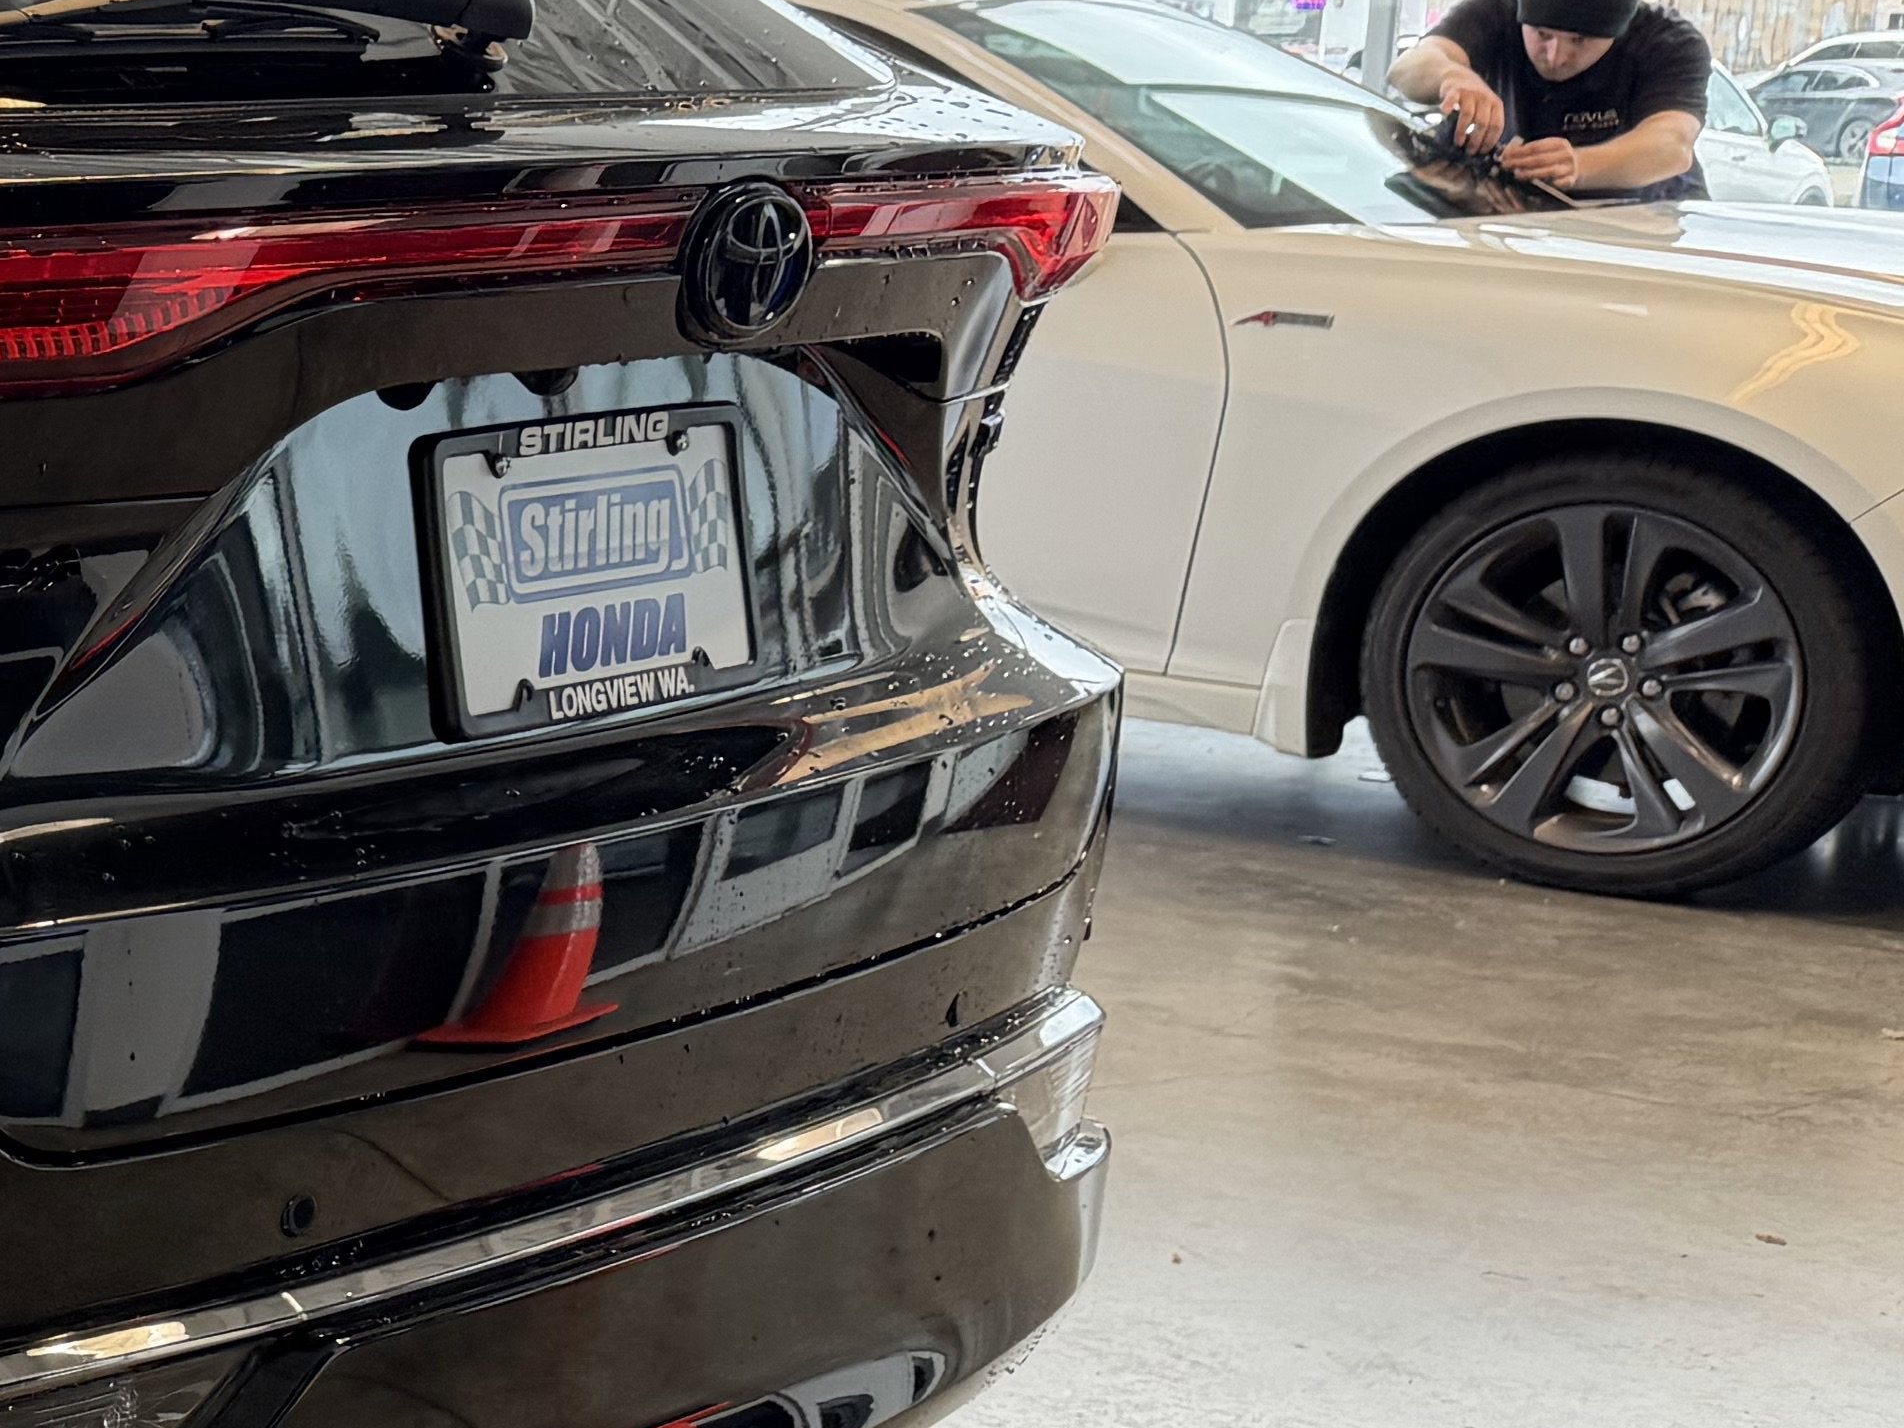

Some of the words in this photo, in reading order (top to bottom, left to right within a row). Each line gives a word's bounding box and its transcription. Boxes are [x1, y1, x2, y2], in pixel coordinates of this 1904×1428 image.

[519, 411, 670, 456] STIRLING
[519, 493, 672, 577] Stirling
[538, 593, 687, 679] HONDA
[549, 671, 655, 720] LONGVIEW
[656, 666, 696, 699] WA.
